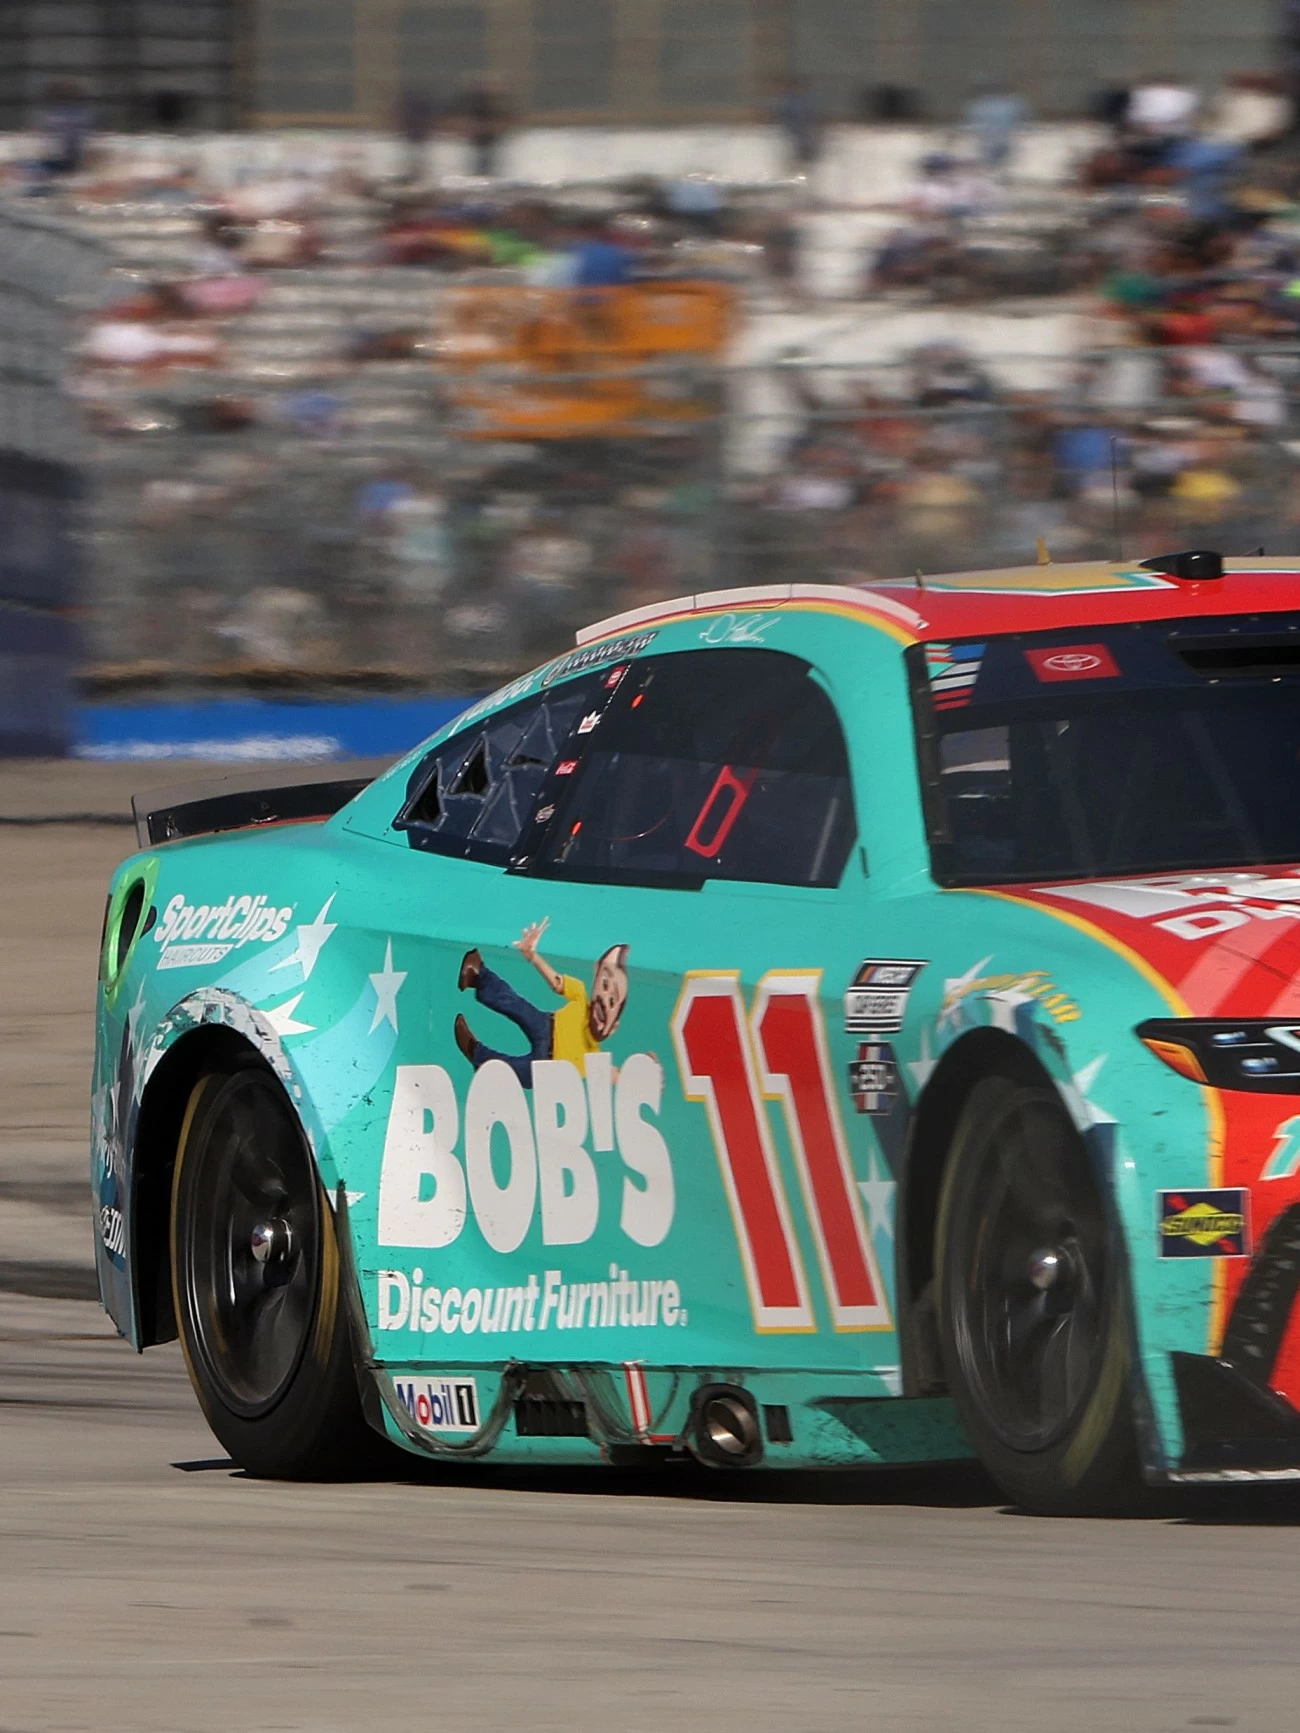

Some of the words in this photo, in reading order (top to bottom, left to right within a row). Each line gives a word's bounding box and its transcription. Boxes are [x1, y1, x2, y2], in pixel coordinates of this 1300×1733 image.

[378, 1052, 676, 1254] BOB'S
[669, 969, 895, 1334] 11
[377, 1267, 540, 1334] Discount
[538, 1262, 681, 1331] Furniture
[396, 1383, 456, 1426] Mobil
[457, 1386, 474, 1425] 1
